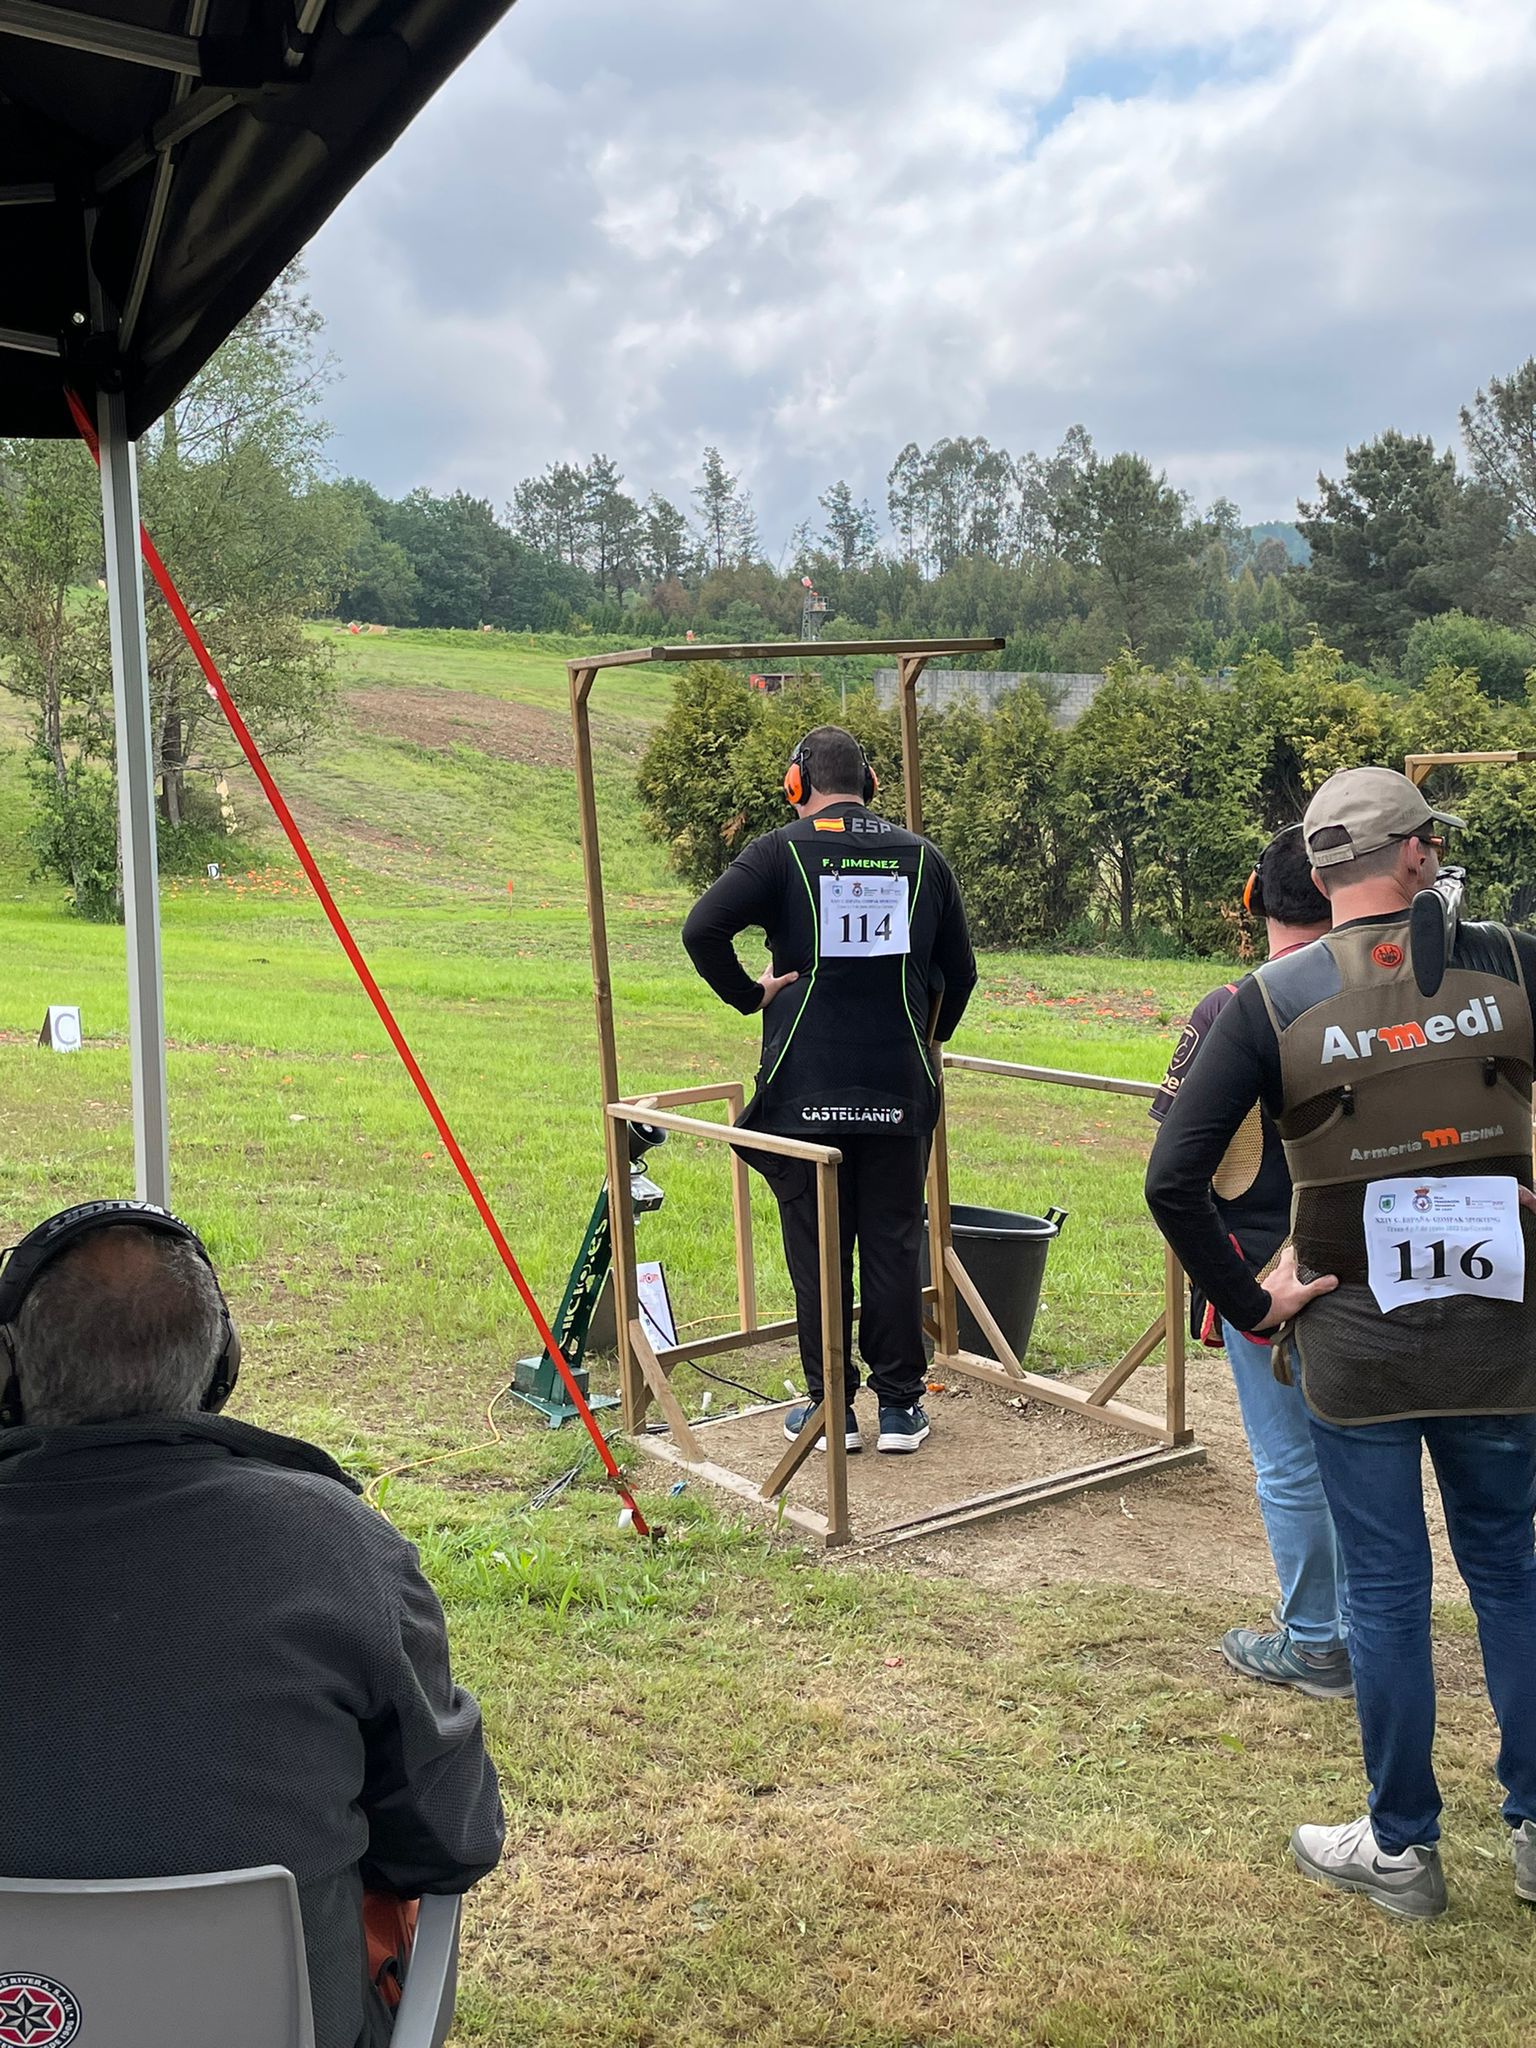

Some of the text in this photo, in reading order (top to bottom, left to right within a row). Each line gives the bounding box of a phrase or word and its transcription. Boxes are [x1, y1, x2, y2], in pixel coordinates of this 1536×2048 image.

[852, 818, 892, 834] ESP
[209, 866, 219, 879] D
[822, 859, 900, 869] F. JIMENEZ
[838, 912, 893, 943] 114
[55, 1013, 77, 1045] C
[1320, 995, 1504, 1065] Armedi
[801, 1107, 891, 1122] CASTELLANI
[1391, 1239, 1494, 1284] 116
